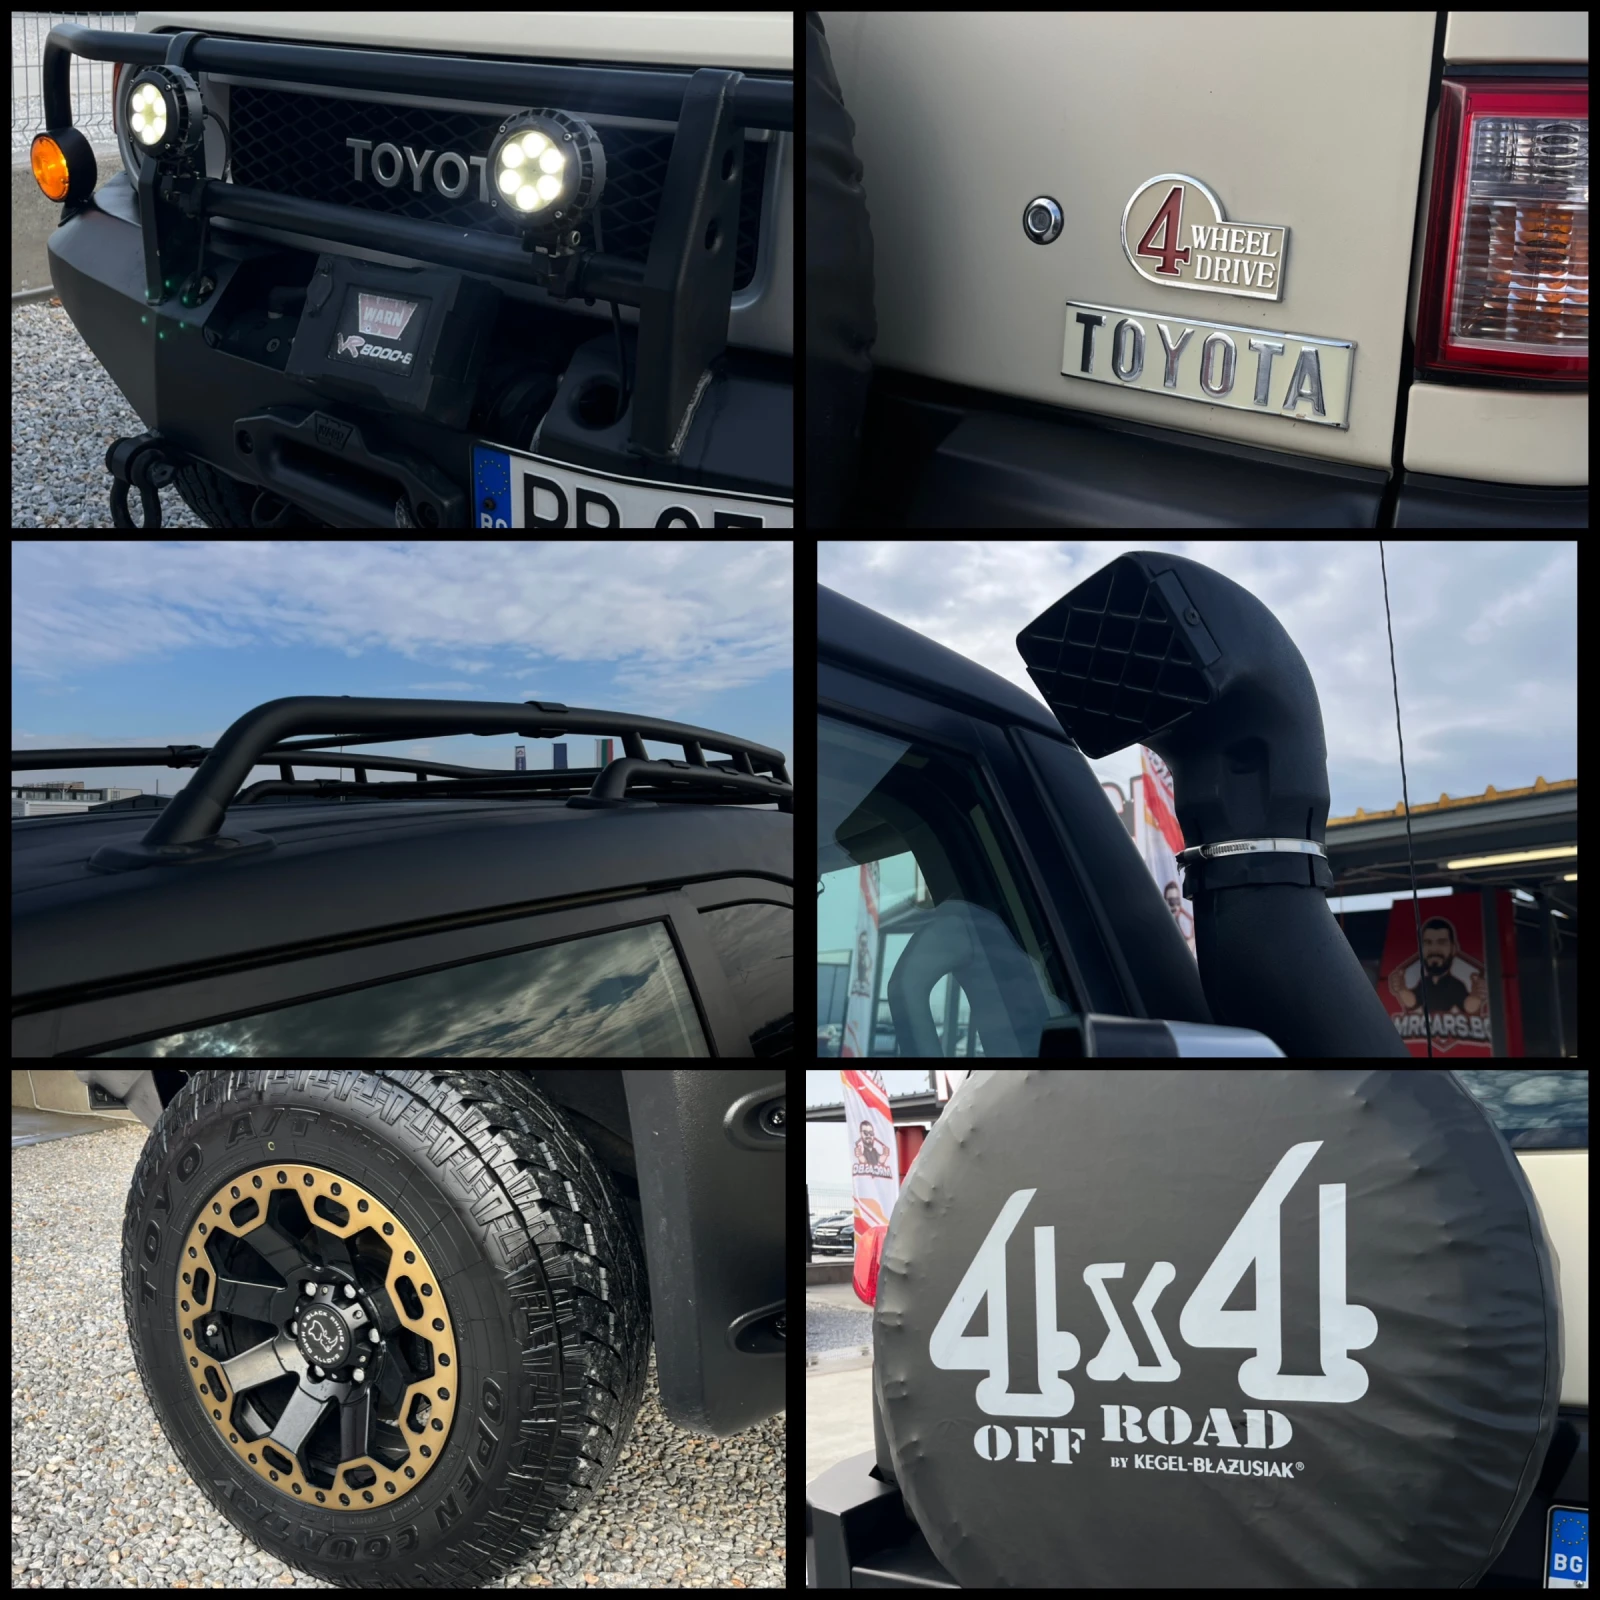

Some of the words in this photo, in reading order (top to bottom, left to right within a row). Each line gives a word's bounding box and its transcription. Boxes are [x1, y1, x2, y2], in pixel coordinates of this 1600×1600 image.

[1136, 185, 1192, 276] 4
[1191, 225, 1279, 257] WHEEL
[1194, 254, 1276, 289] DRIVE
[363, 306, 404, 327] WARN
[1076, 312, 1326, 416] TOYOTA
[139, 1142, 203, 1308] TOYO
[225, 1107, 321, 1150] A/T
[929, 1140, 1379, 1418] 4x4
[301, 1331, 313, 1353] HARD
[313, 1353, 340, 1363] ALLOYS
[306, 1310, 328, 1320] BLACK
[330, 1315, 344, 1342] RHINO
[432, 1376, 505, 1530] OPEN
[973, 1424, 1086, 1464] OFF
[1100, 1403, 1293, 1449] ROAD
[1110, 1456, 1129, 1468] BY
[213, 1478, 420, 1561] COUNTRY
[1554, 1552, 1583, 1573] BG
